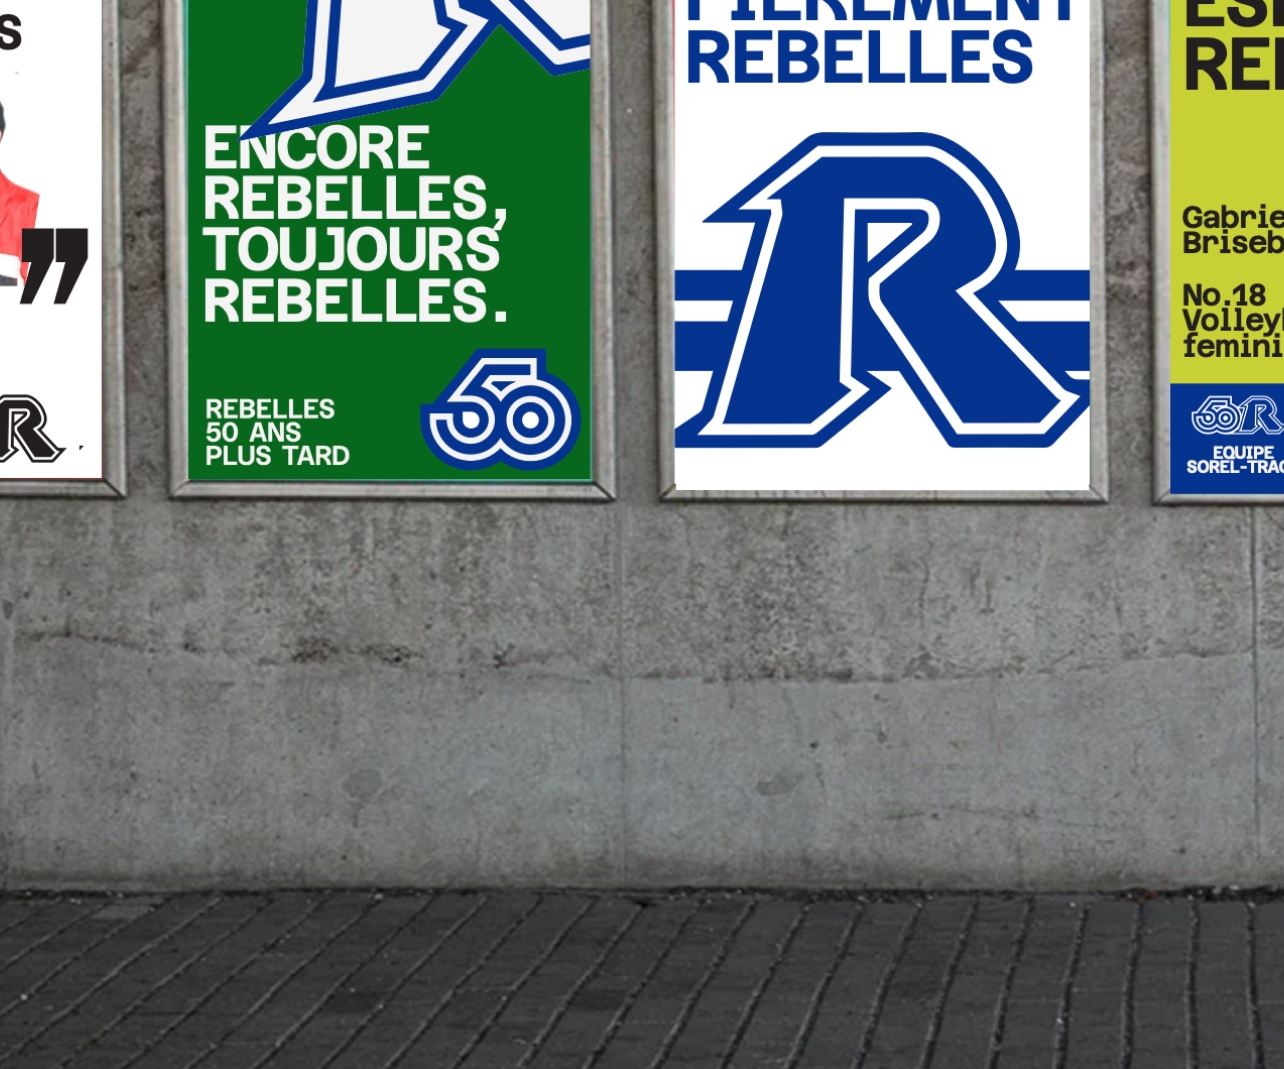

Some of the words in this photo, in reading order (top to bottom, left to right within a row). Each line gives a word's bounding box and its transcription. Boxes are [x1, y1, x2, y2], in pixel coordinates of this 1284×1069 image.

[688, 29, 1032, 84] REBELLES
[204, 125, 430, 169] ENCORE
[204, 175, 507, 230] REBELLES,
[202, 226, 500, 271] TOUJOURS
[205, 278, 506, 322] REBELLES.
[1184, 283, 1265, 306] No.18
[207, 399, 334, 419] REBELLES
[207, 422, 238, 442] 50
[250, 422, 301, 442] ANS
[207, 445, 271, 465] PLUS
[282, 446, 349, 465] TARD
[1214, 446, 1274, 459] EQUIPE
